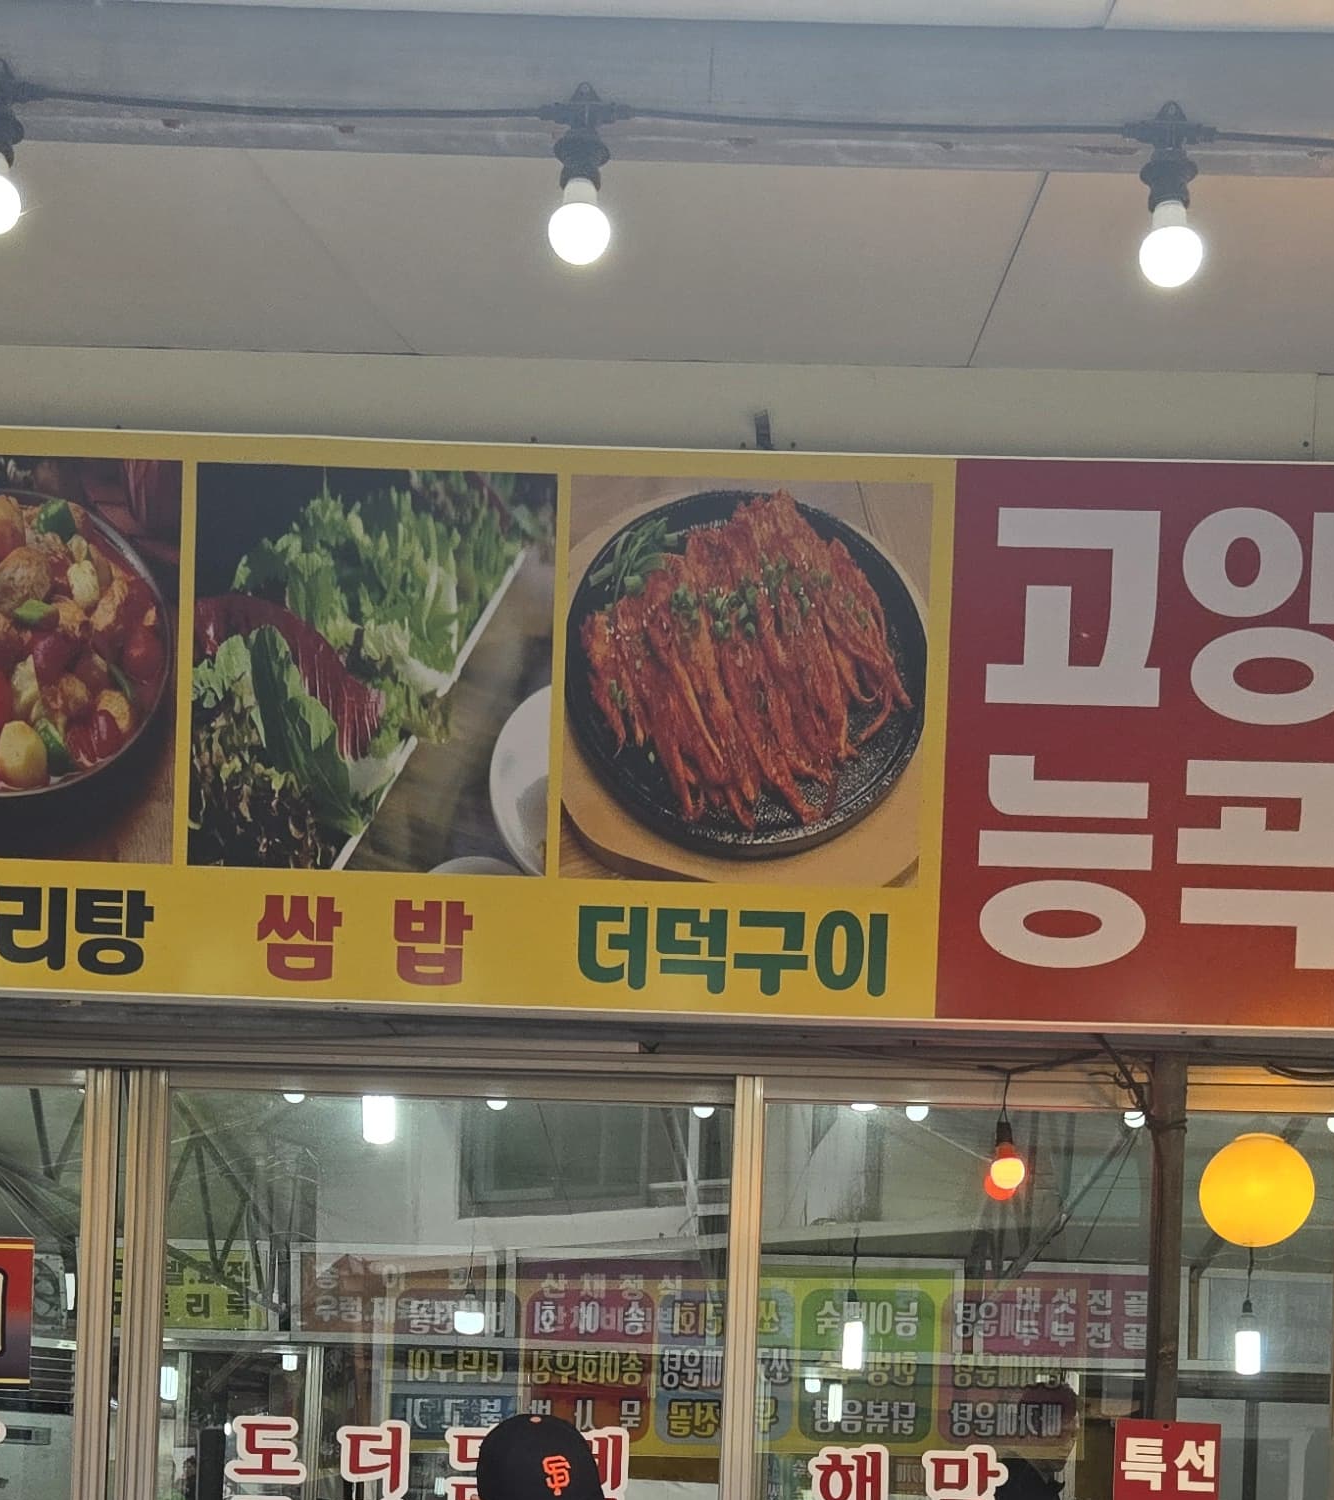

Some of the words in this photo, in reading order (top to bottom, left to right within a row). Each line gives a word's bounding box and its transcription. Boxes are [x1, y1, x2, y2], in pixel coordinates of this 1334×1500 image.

[576, 904, 890, 998] 더덕구이
[542, 1455, 572, 1496] SF
[1120, 1436, 1216, 1493] 특선
